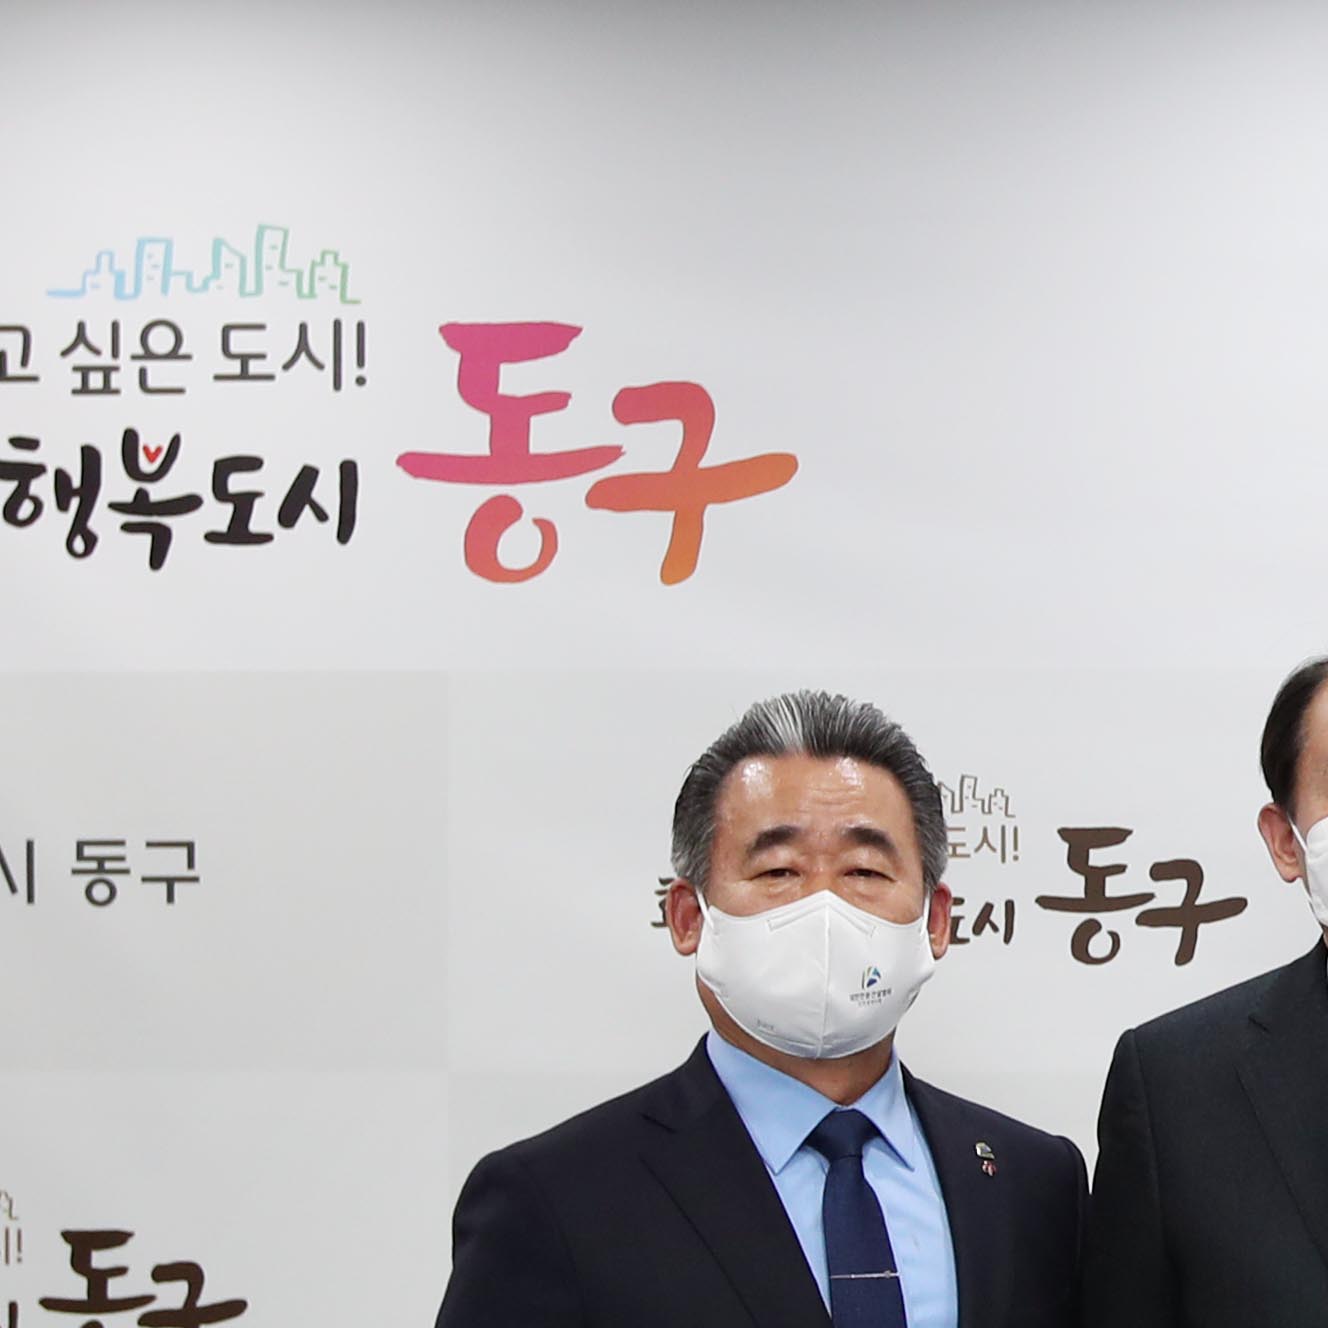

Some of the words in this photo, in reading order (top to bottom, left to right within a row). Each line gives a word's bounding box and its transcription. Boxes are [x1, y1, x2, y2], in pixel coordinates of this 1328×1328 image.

[60, 317, 193, 396] 싶은
[213, 317, 367, 392] 도시!
[0, 427, 359, 571] 행복도시
[396, 322, 799, 586] 동구
[71, 839, 200, 907] 동구
[1035, 827, 1248, 966] 동구
